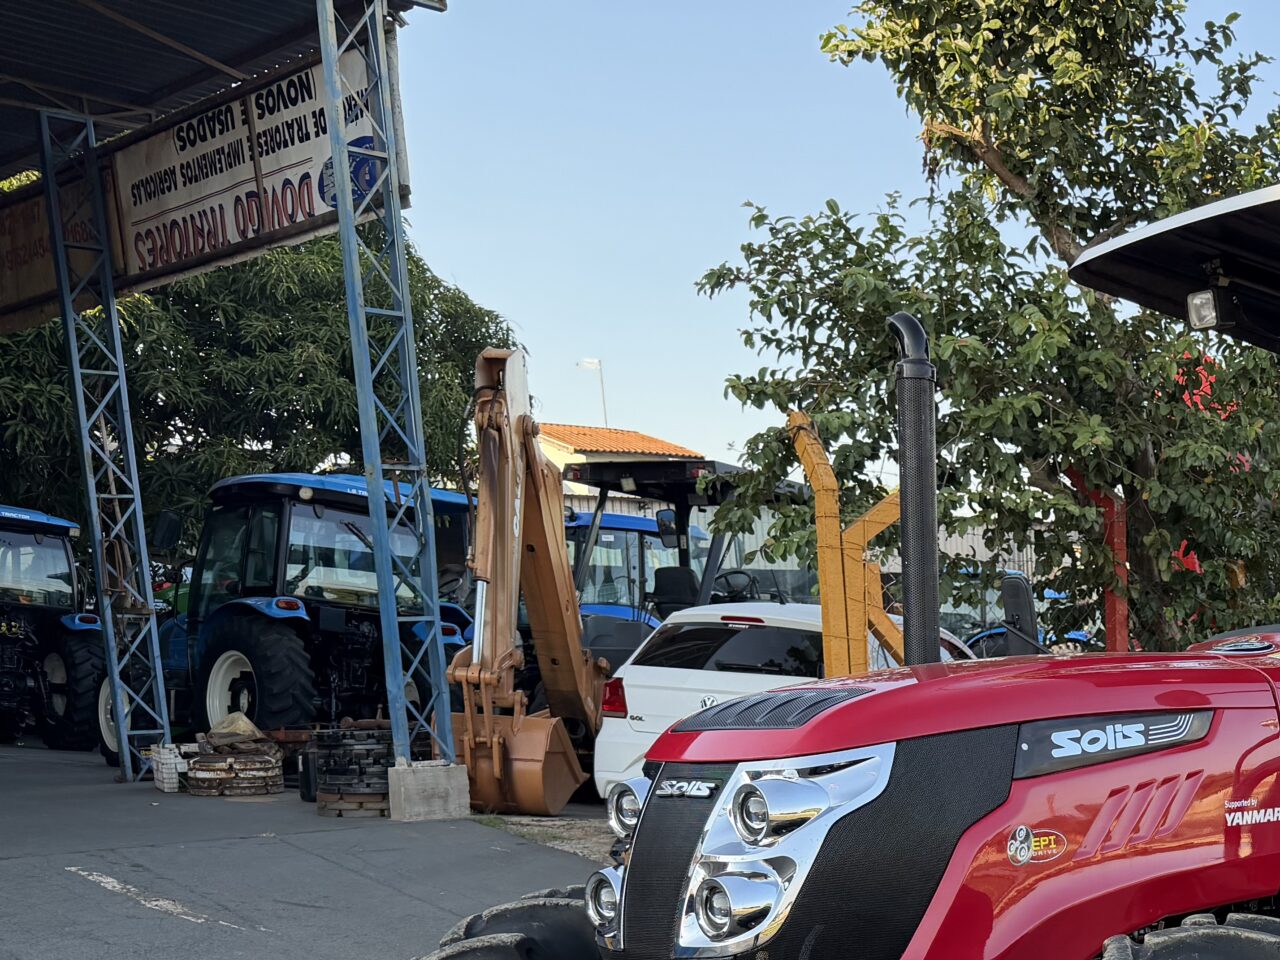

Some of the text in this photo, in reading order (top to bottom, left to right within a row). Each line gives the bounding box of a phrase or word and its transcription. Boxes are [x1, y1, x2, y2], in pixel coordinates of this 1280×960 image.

[311, 108, 328, 136] DE
[256, 117, 311, 157] TRATORES
[179, 140, 246, 186] IMPLEMENTOS
[131, 167, 177, 207] AGRÍCOLAS
[133, 204, 231, 272] TRATORES
[629, 714, 646, 722] GOL
[1224, 797, 1258, 809] Supported by
[1031, 835, 1057, 851] EPI
[1032, 849, 1058, 857] DRIVE
